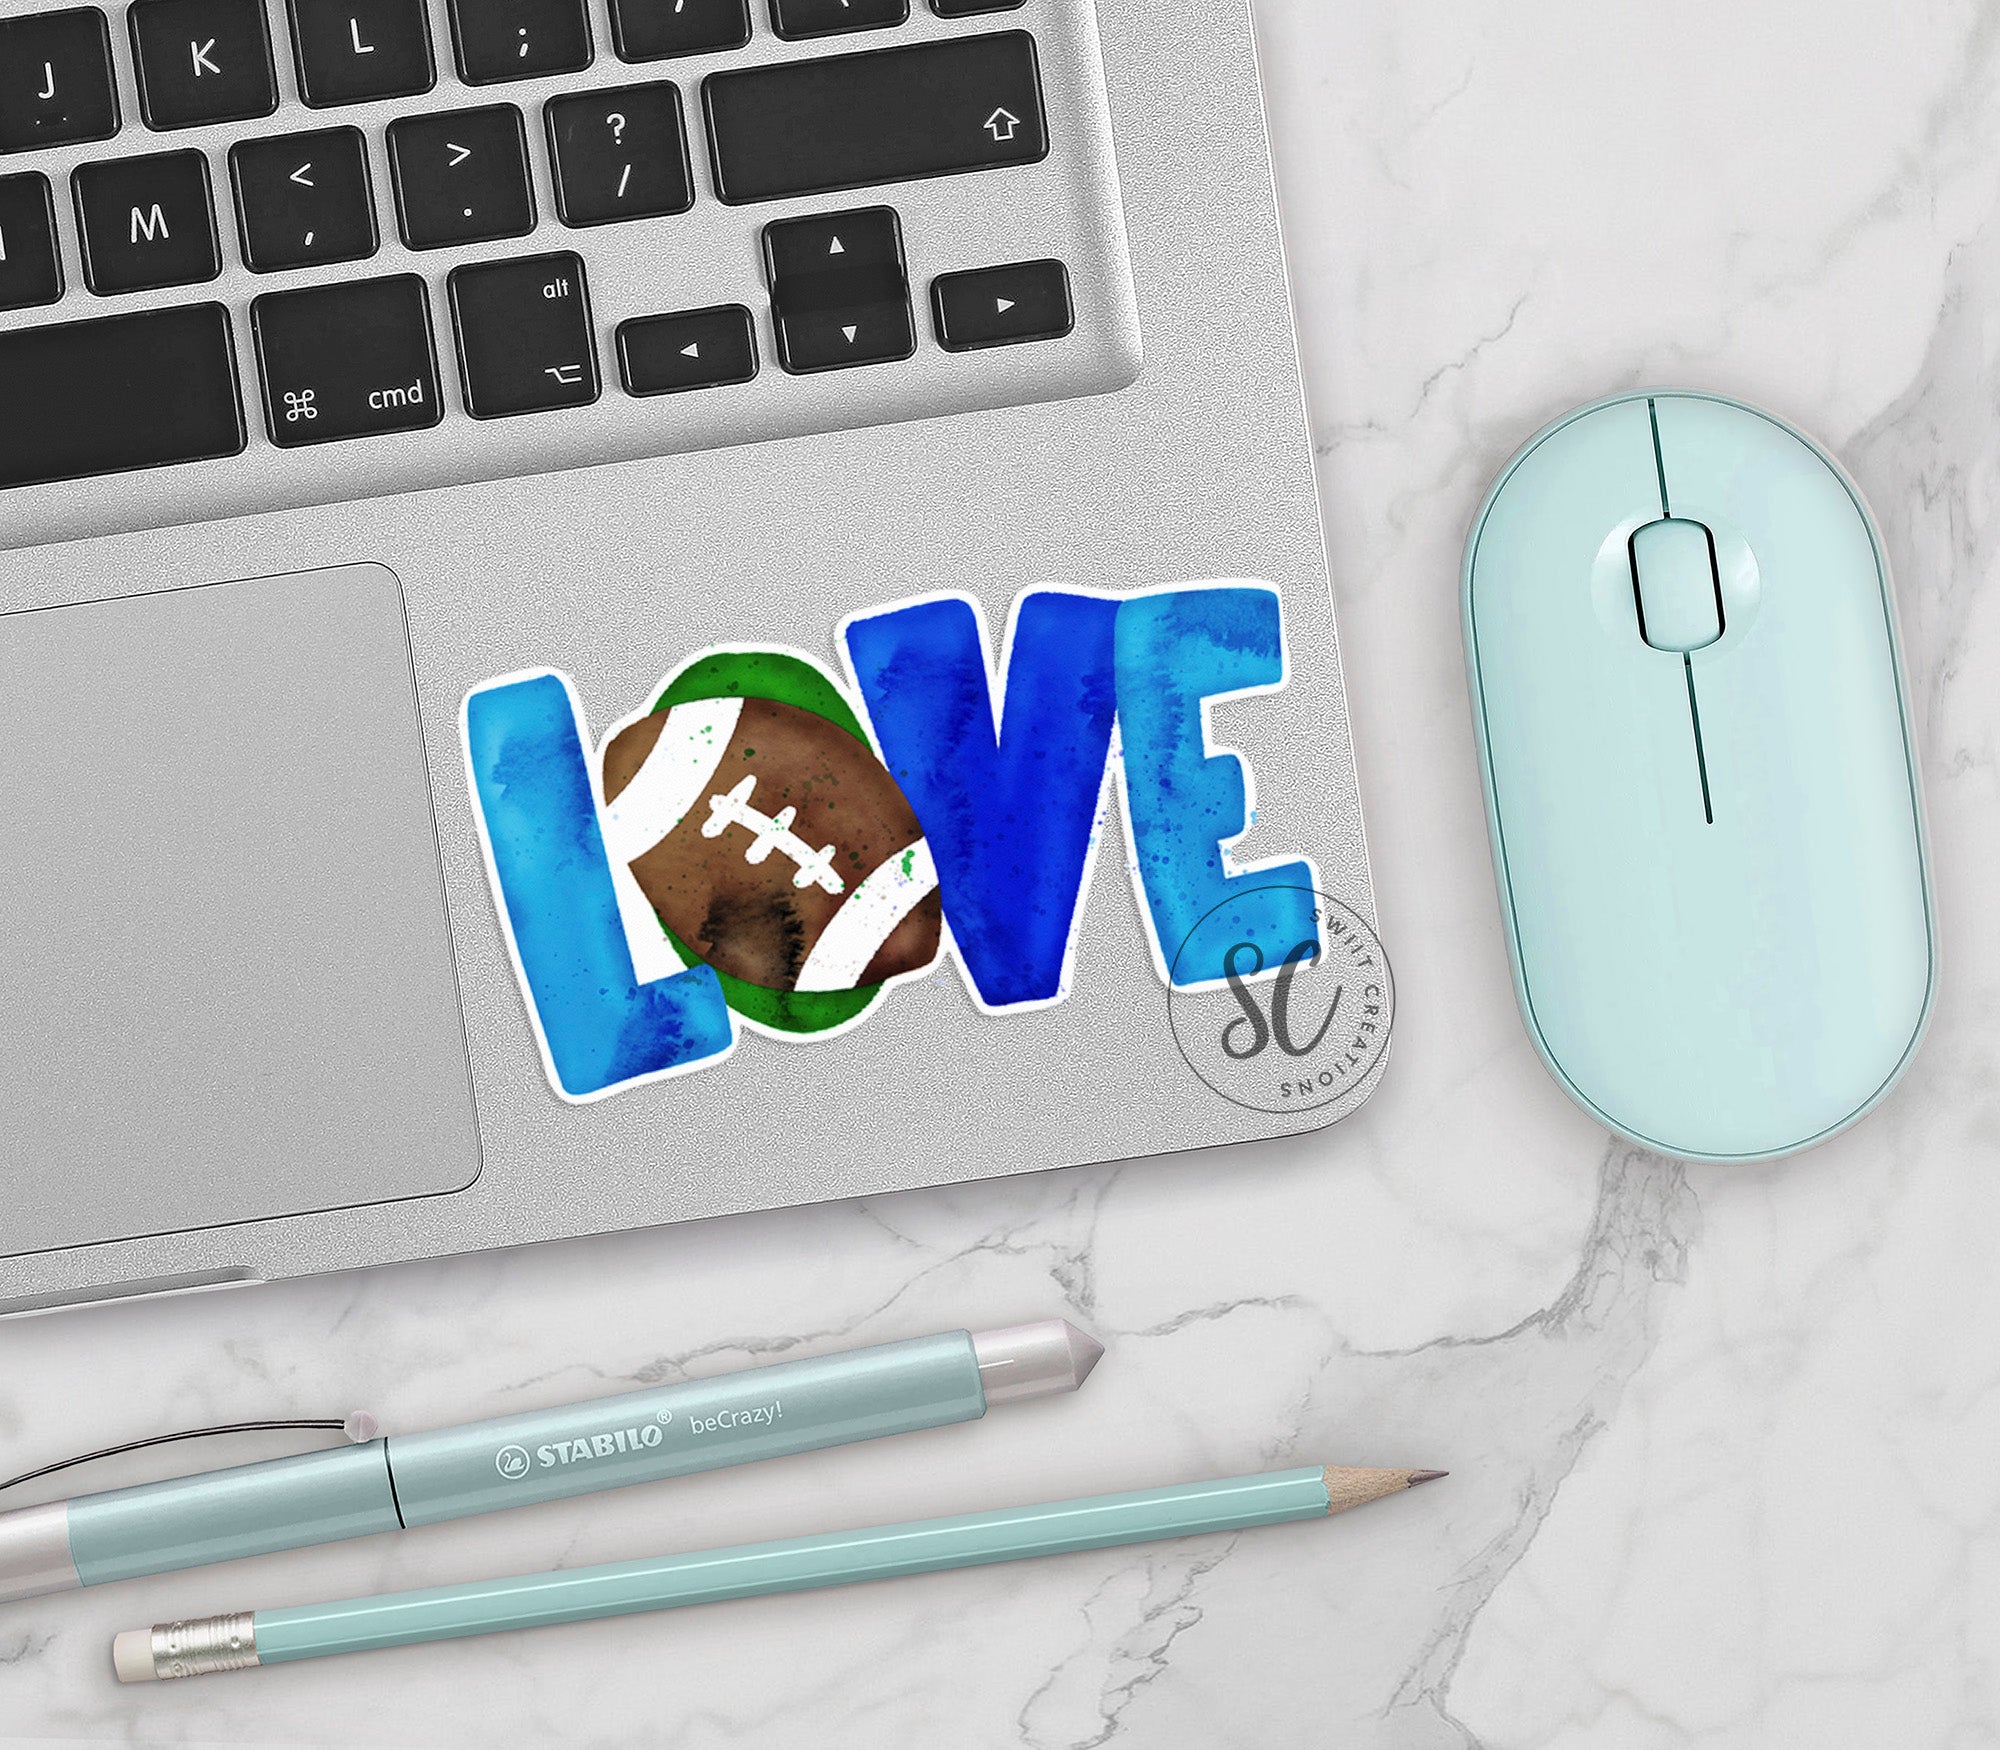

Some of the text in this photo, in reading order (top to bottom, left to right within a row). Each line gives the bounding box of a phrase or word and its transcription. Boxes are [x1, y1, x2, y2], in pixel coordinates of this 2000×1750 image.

[350, 17, 375, 54] L
[518, 28, 529, 58] ;
[190, 38, 221, 77] K
[37, 61, 55, 99] J
[606, 113, 626, 145] ?
[446, 143, 471, 167] >
[289, 162, 314, 187] <
[617, 163, 632, 197] /
[130, 203, 170, 244] M
[542, 278, 569, 299] alt
[368, 378, 424, 410] cmd
[467, 587, 1318, 1096] LOVE
[690, 1400, 783, 1435] beCrazy!
